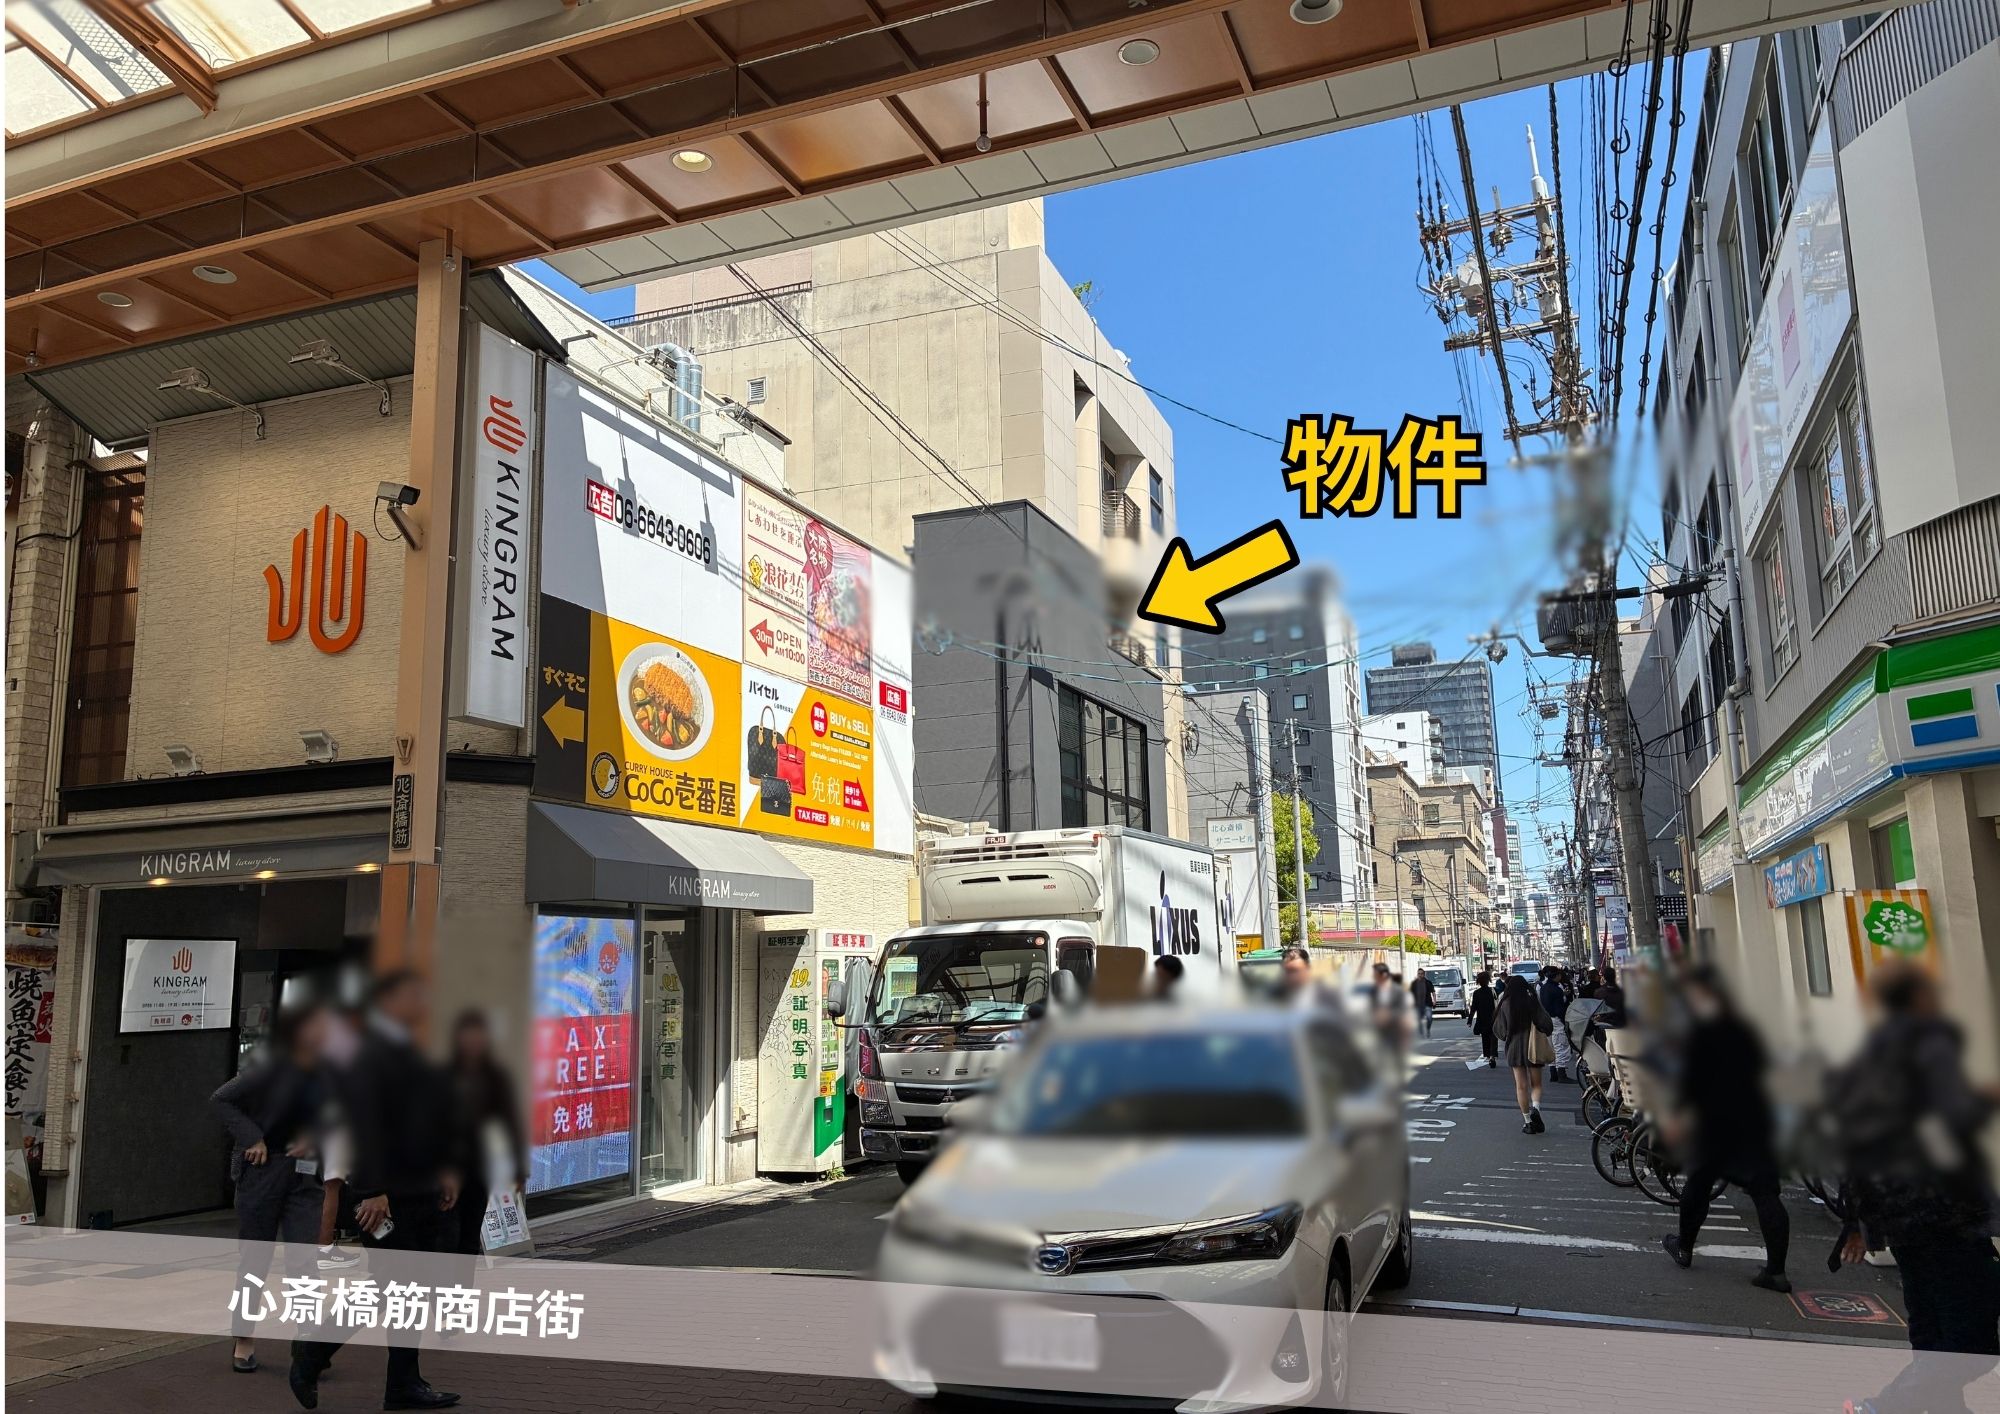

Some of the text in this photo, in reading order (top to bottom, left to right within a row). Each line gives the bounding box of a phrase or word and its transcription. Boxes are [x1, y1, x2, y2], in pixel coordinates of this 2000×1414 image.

[588, 484, 613, 518] 広告
[614, 493, 711, 564] 06-6643-0606
[477, 508, 493, 606] luxury store
[489, 459, 520, 661] KINGRAM
[764, 559, 788, 592] 浪花
[789, 572, 805, 589] オム
[790, 587, 805, 600] ライス
[755, 628, 773, 647] 30m
[776, 629, 802, 650] OPEN
[542, 666, 586, 693] すぐそこ
[749, 680, 780, 701] バイセル
[887, 688, 901, 706] 広告
[830, 711, 847, 728] BUY
[852, 719, 871, 736] SELL
[624, 761, 674, 779] CURRY HOUSE
[624, 772, 736, 817] CoCo壱番屋
[812, 772, 841, 805] 免税
[797, 809, 826, 824] TAX FREE
[1212, 823, 1243, 833] 北心斎橋
[1215, 835, 1254, 844] サニービル
[140, 850, 231, 876] KINGRAM
[235, 856, 281, 867] luxury store
[669, 875, 730, 899] KINGRAM
[1879, 907, 1923, 928] チキン
[768, 936, 806, 947] 証明写真
[832, 934, 866, 948] 証明写真
[153, 975, 208, 988] KINGRAM
[792, 995, 809, 1080] 証明写真
[553, 1102, 594, 1134] 免税
